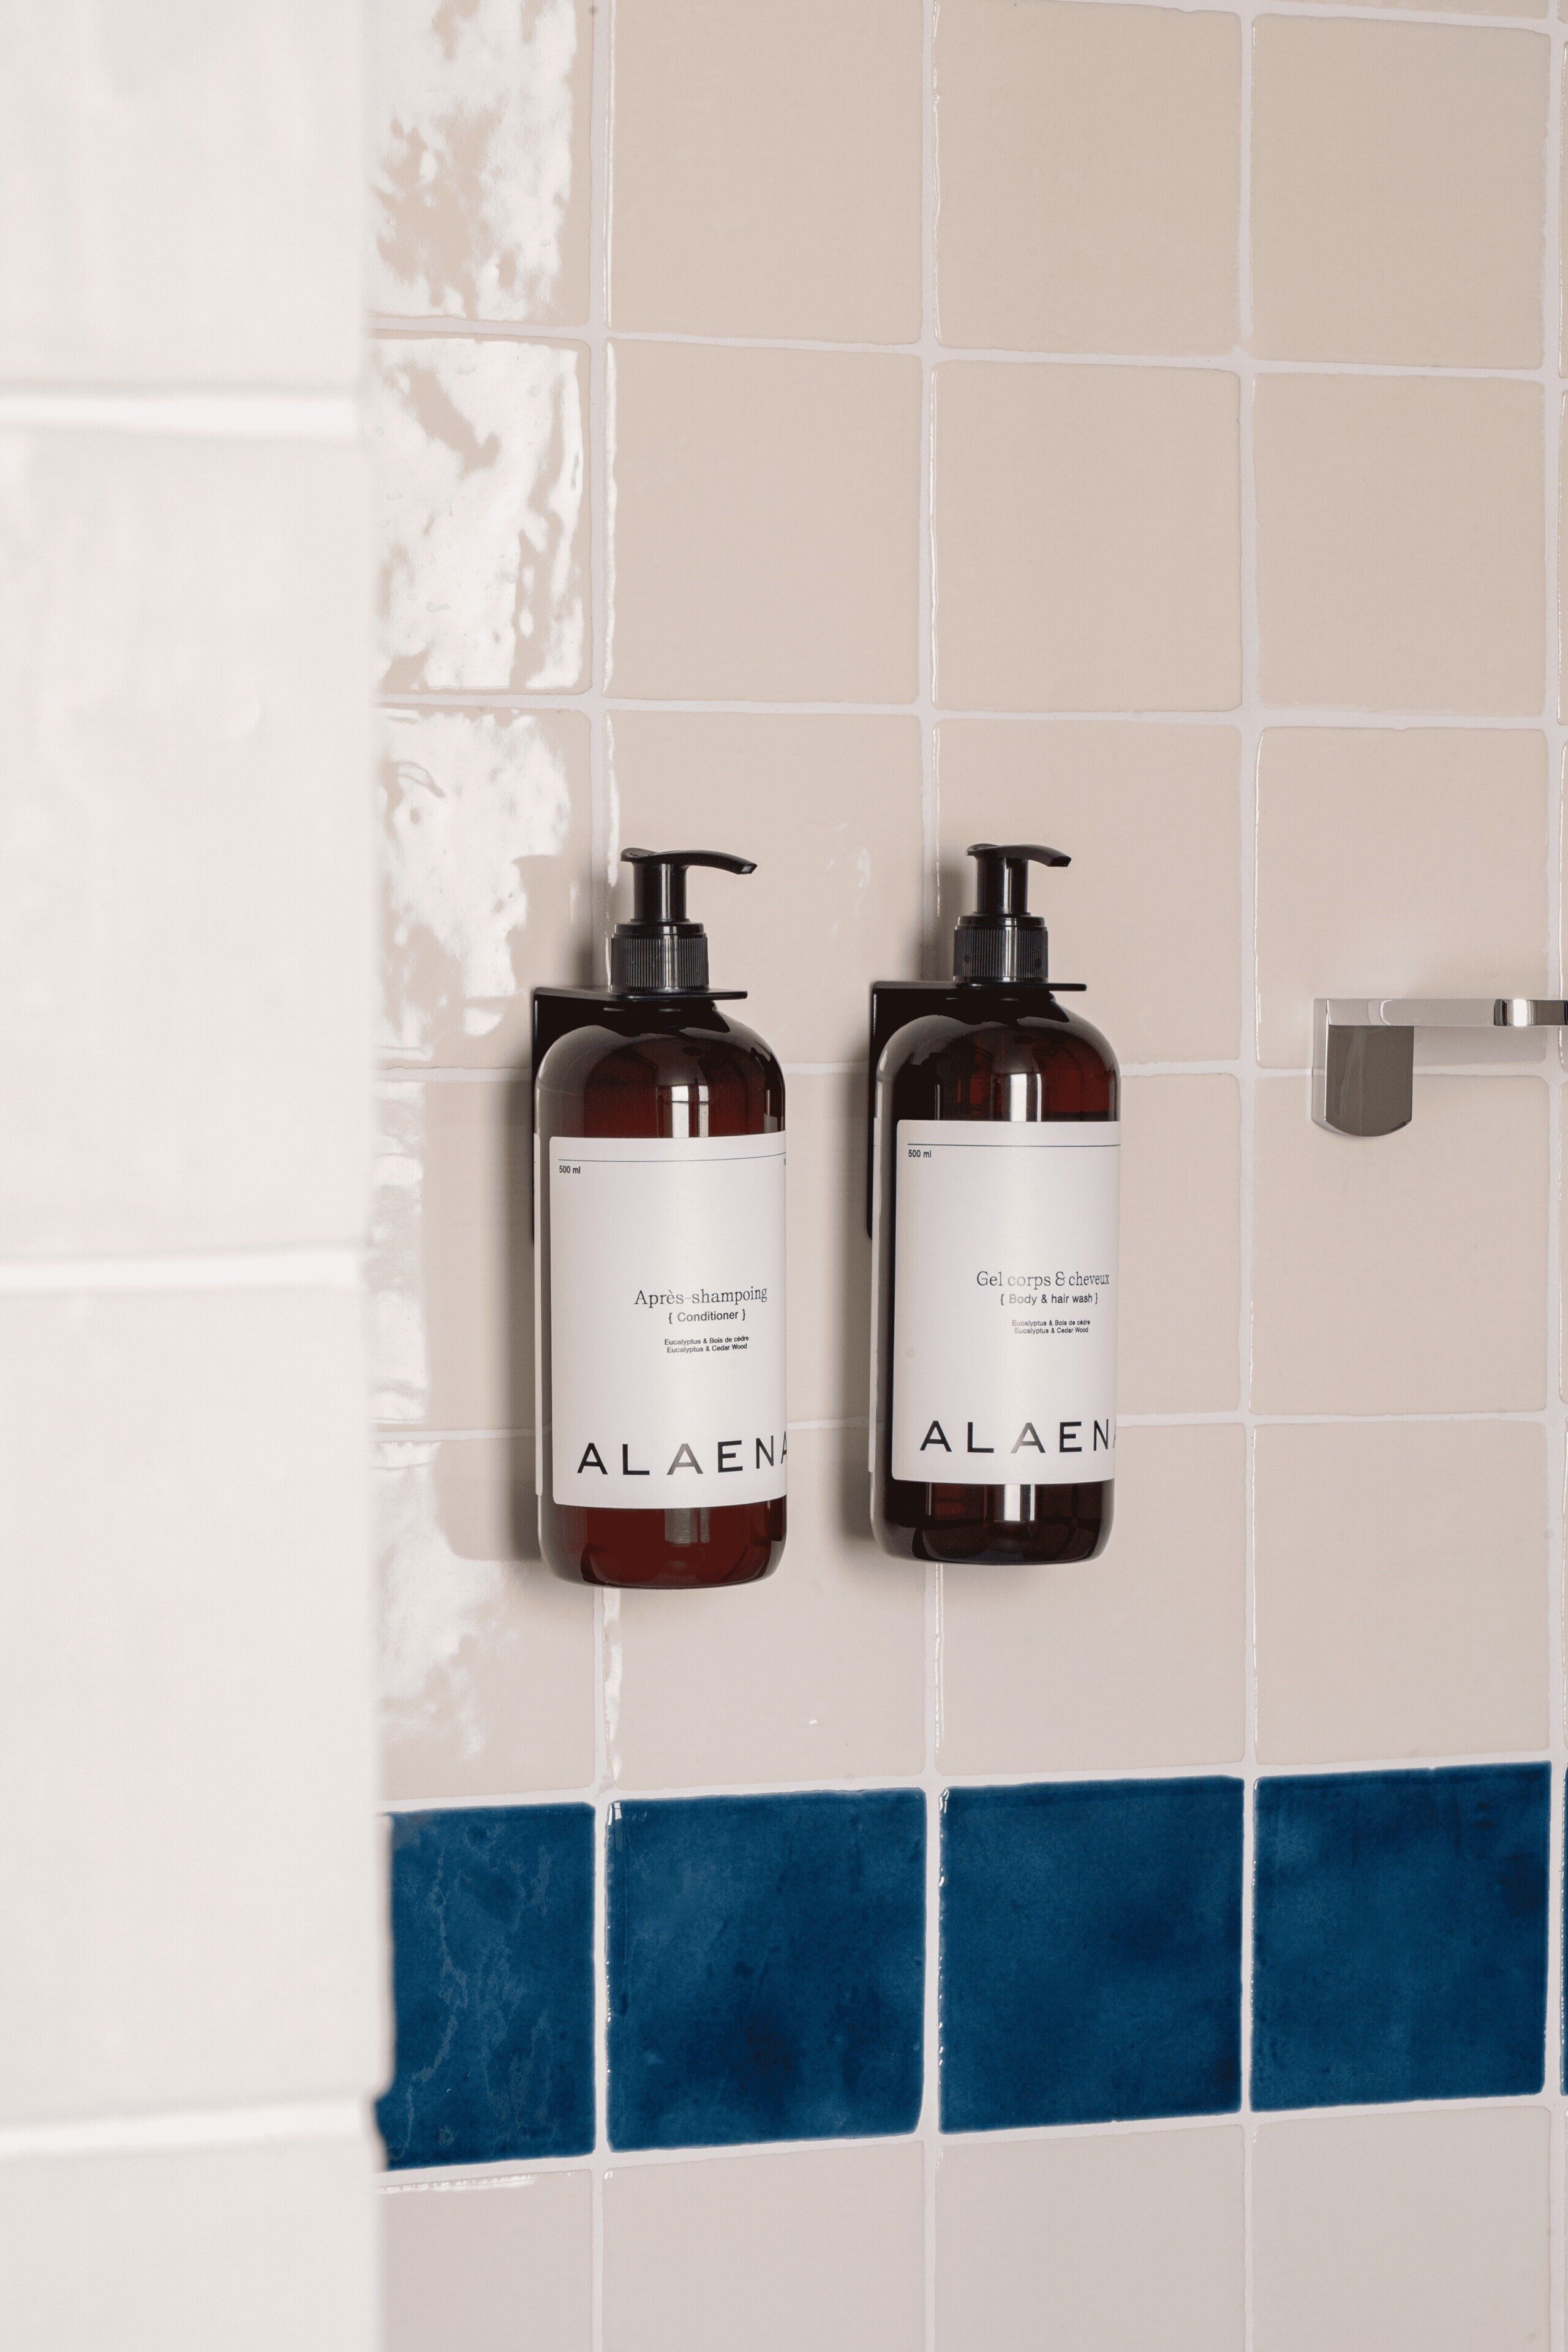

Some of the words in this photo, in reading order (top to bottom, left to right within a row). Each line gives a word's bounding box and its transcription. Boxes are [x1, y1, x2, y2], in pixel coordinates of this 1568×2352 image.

[908, 1149, 921, 1158] 500
[559, 1165, 571, 1174] 500
[572, 1166, 581, 1174] ml
[976, 1271, 1003, 1286] Gel
[1008, 1275, 1051, 1290] corps
[1055, 1272, 1065, 1286] &
[1069, 1271, 1110, 1286] cheveux
[633, 1286, 768, 1309] Après-shampoing
[1009, 1294, 1038, 1305] Body
[1041, 1294, 1048, 1304] &
[1051, 1294, 1069, 1304] hair
[1072, 1293, 1093, 1303] wash
[677, 1311, 739, 1322] Conditioner
[919, 1419, 1116, 1454] ALAEN
